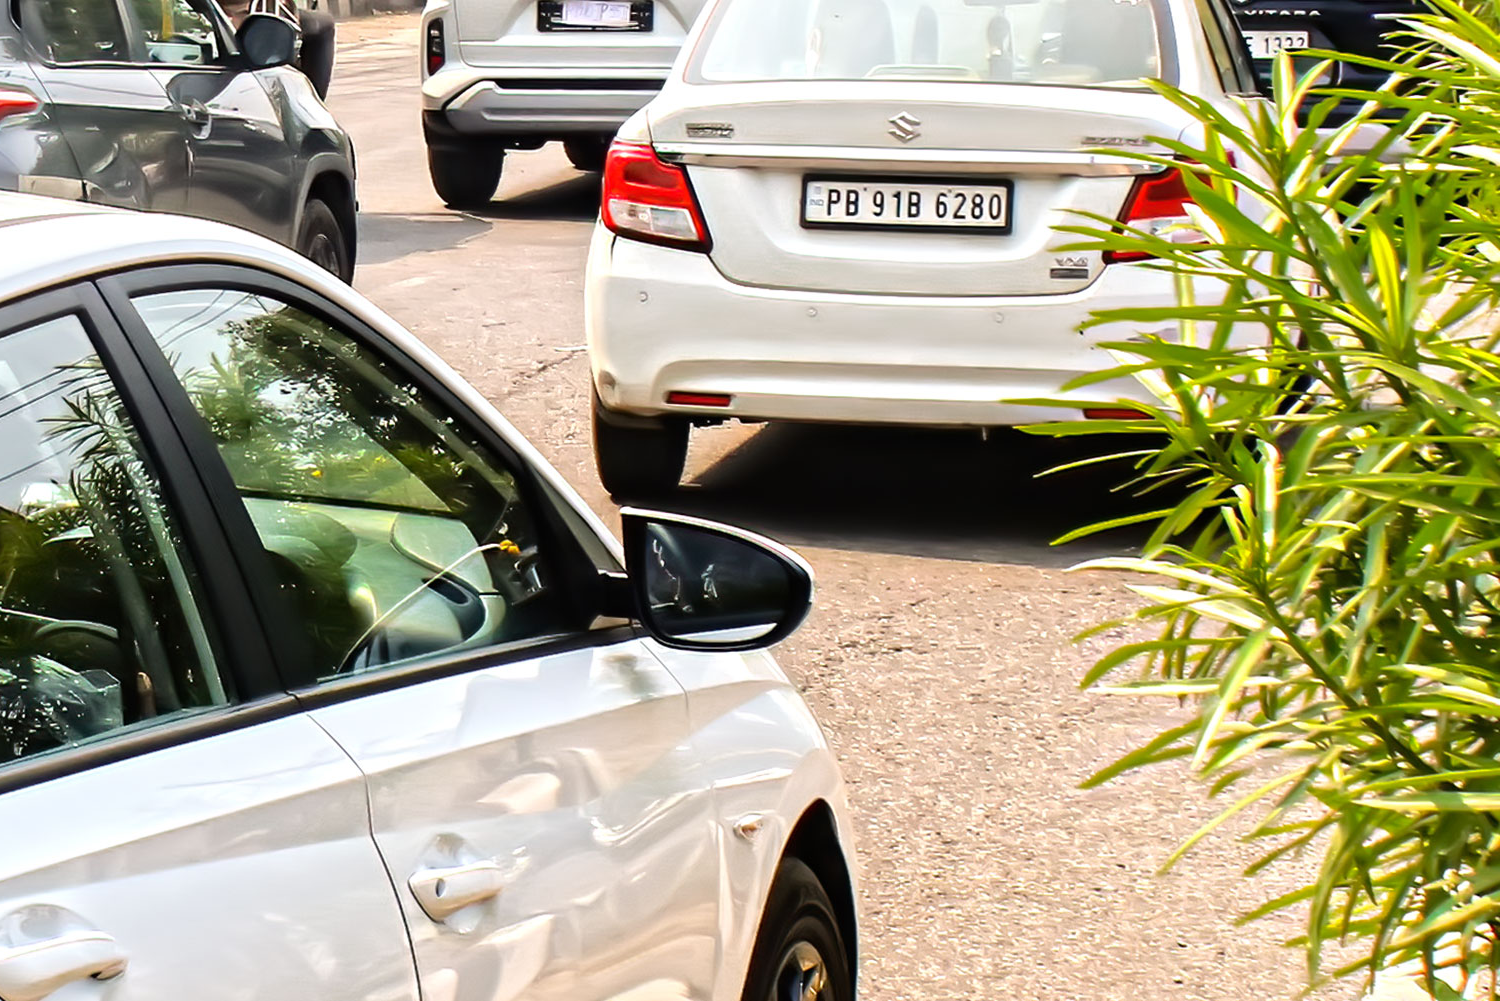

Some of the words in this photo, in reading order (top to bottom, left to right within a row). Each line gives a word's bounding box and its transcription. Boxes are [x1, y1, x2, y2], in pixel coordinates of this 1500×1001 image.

[827, 188, 860, 217] PB
[872, 190, 921, 219] 91B
[936, 192, 1002, 221] 6280
